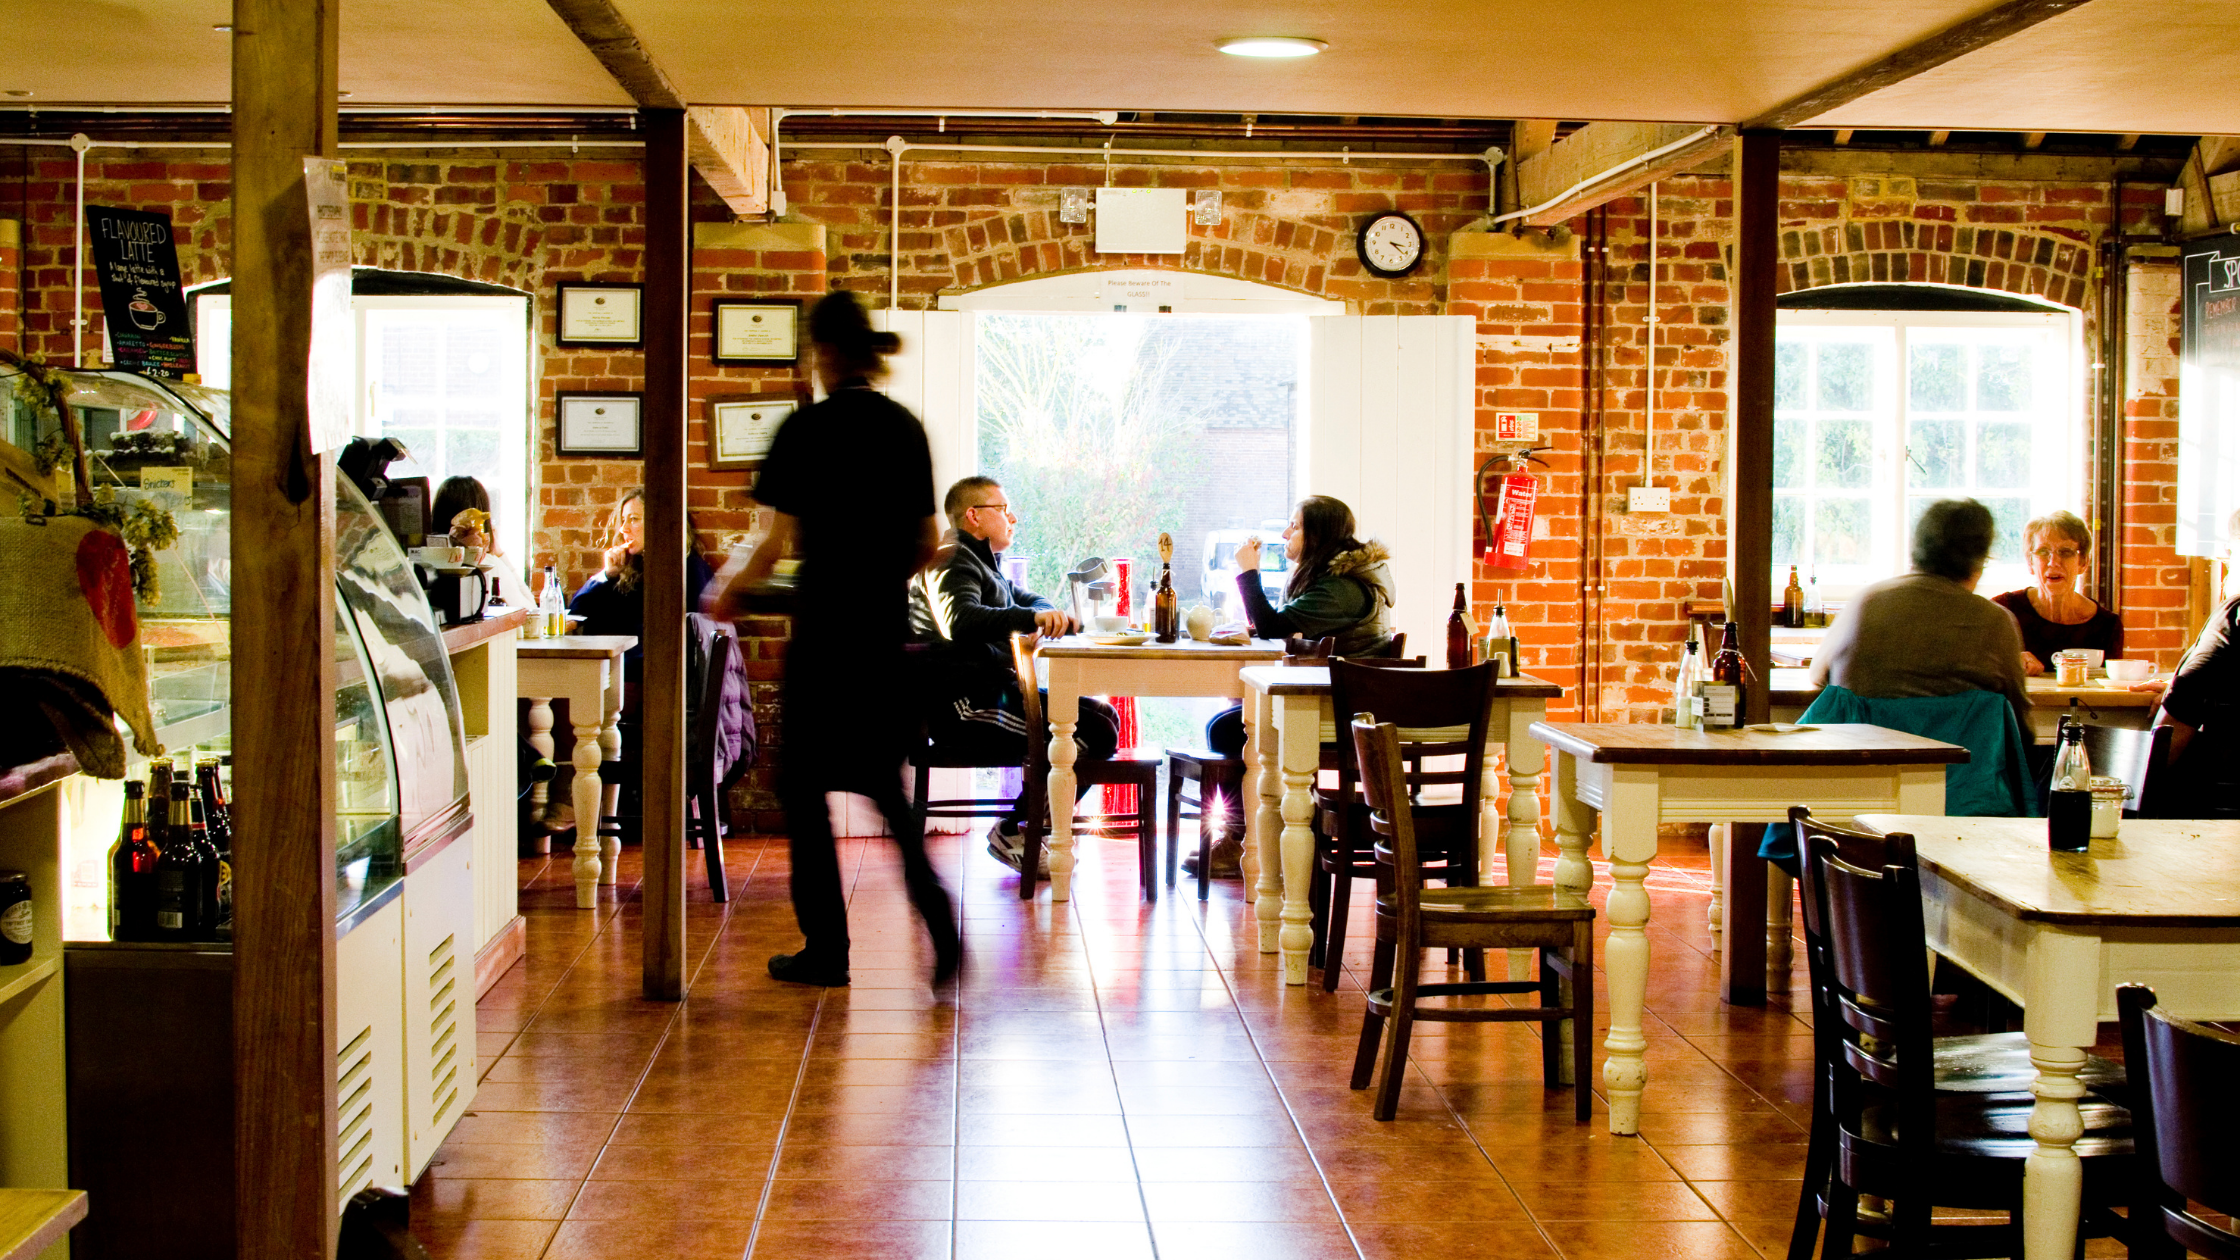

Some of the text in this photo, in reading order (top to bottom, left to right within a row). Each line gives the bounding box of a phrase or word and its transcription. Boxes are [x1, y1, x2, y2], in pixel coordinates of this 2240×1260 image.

[101, 217, 167, 245] FLAVOURED
[120, 239, 155, 263] LATTE
[128, 263, 145, 273] latte
[145, 265, 158, 275] with
[160, 279, 176, 294] syrup
[1511, 489, 1532, 498] Water
[1158, 537, 1172, 552] 14
